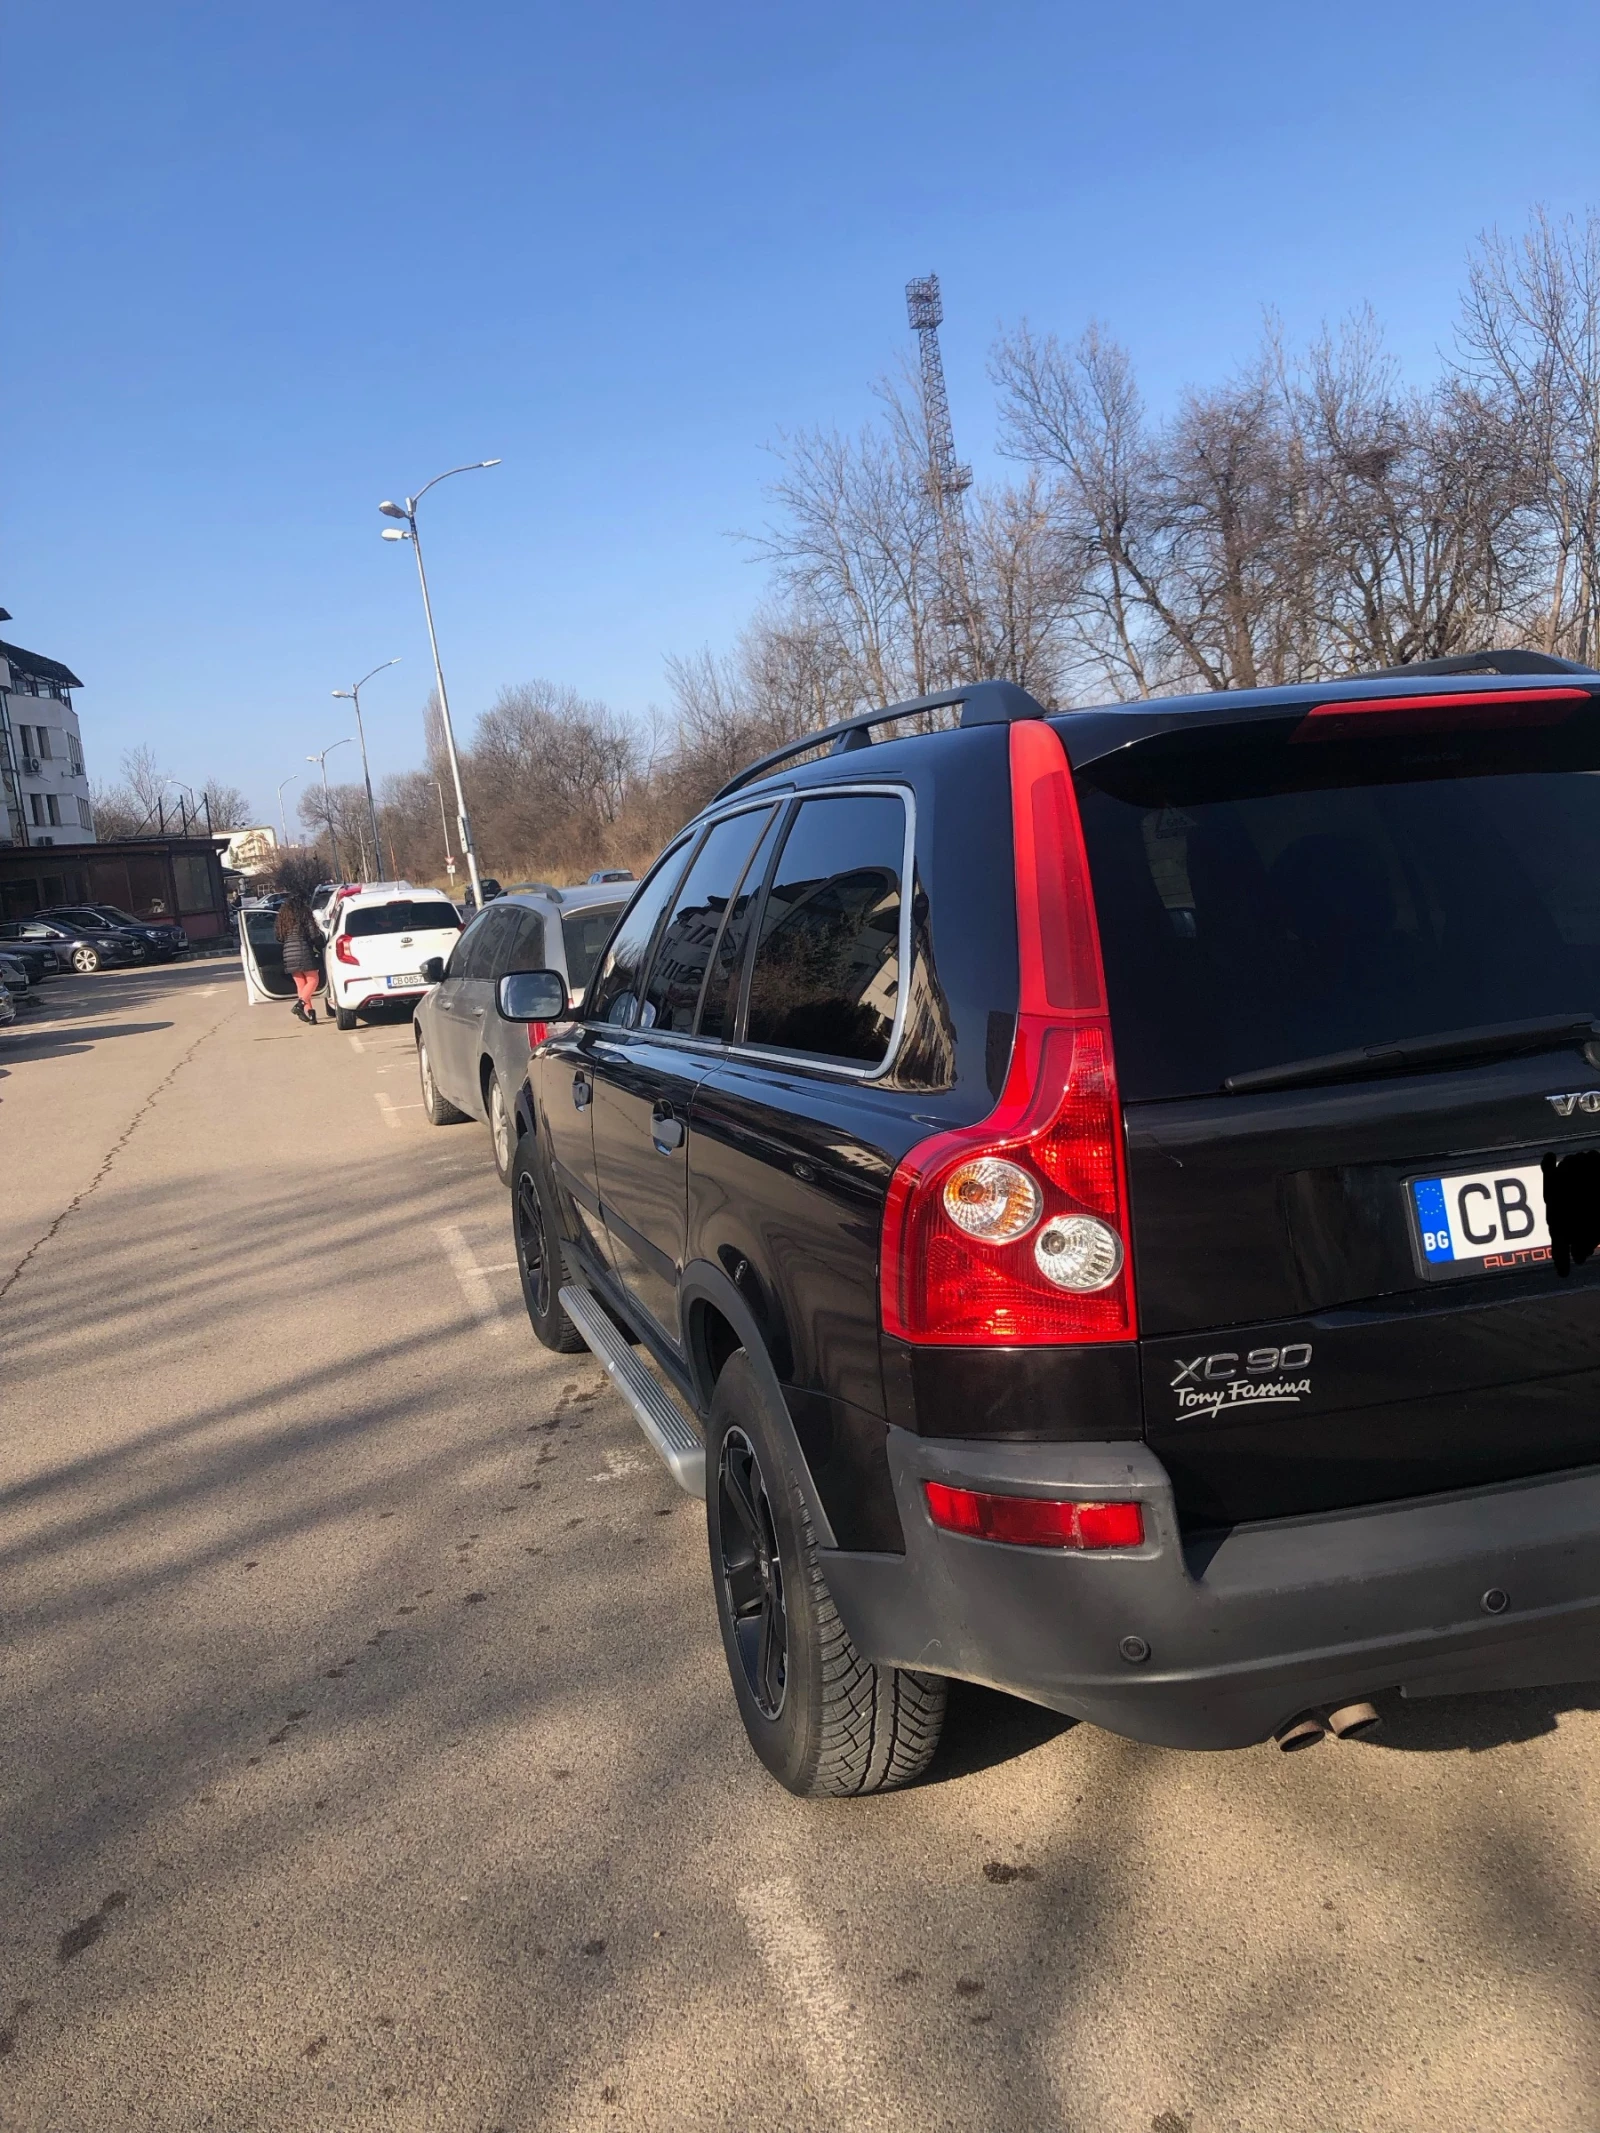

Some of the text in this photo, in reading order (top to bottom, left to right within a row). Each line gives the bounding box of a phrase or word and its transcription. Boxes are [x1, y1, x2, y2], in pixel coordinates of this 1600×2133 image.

[1457, 1177, 1535, 1245] CB
[1423, 1230, 1449, 1251] BG
[1173, 1387, 1225, 1419] Tony
